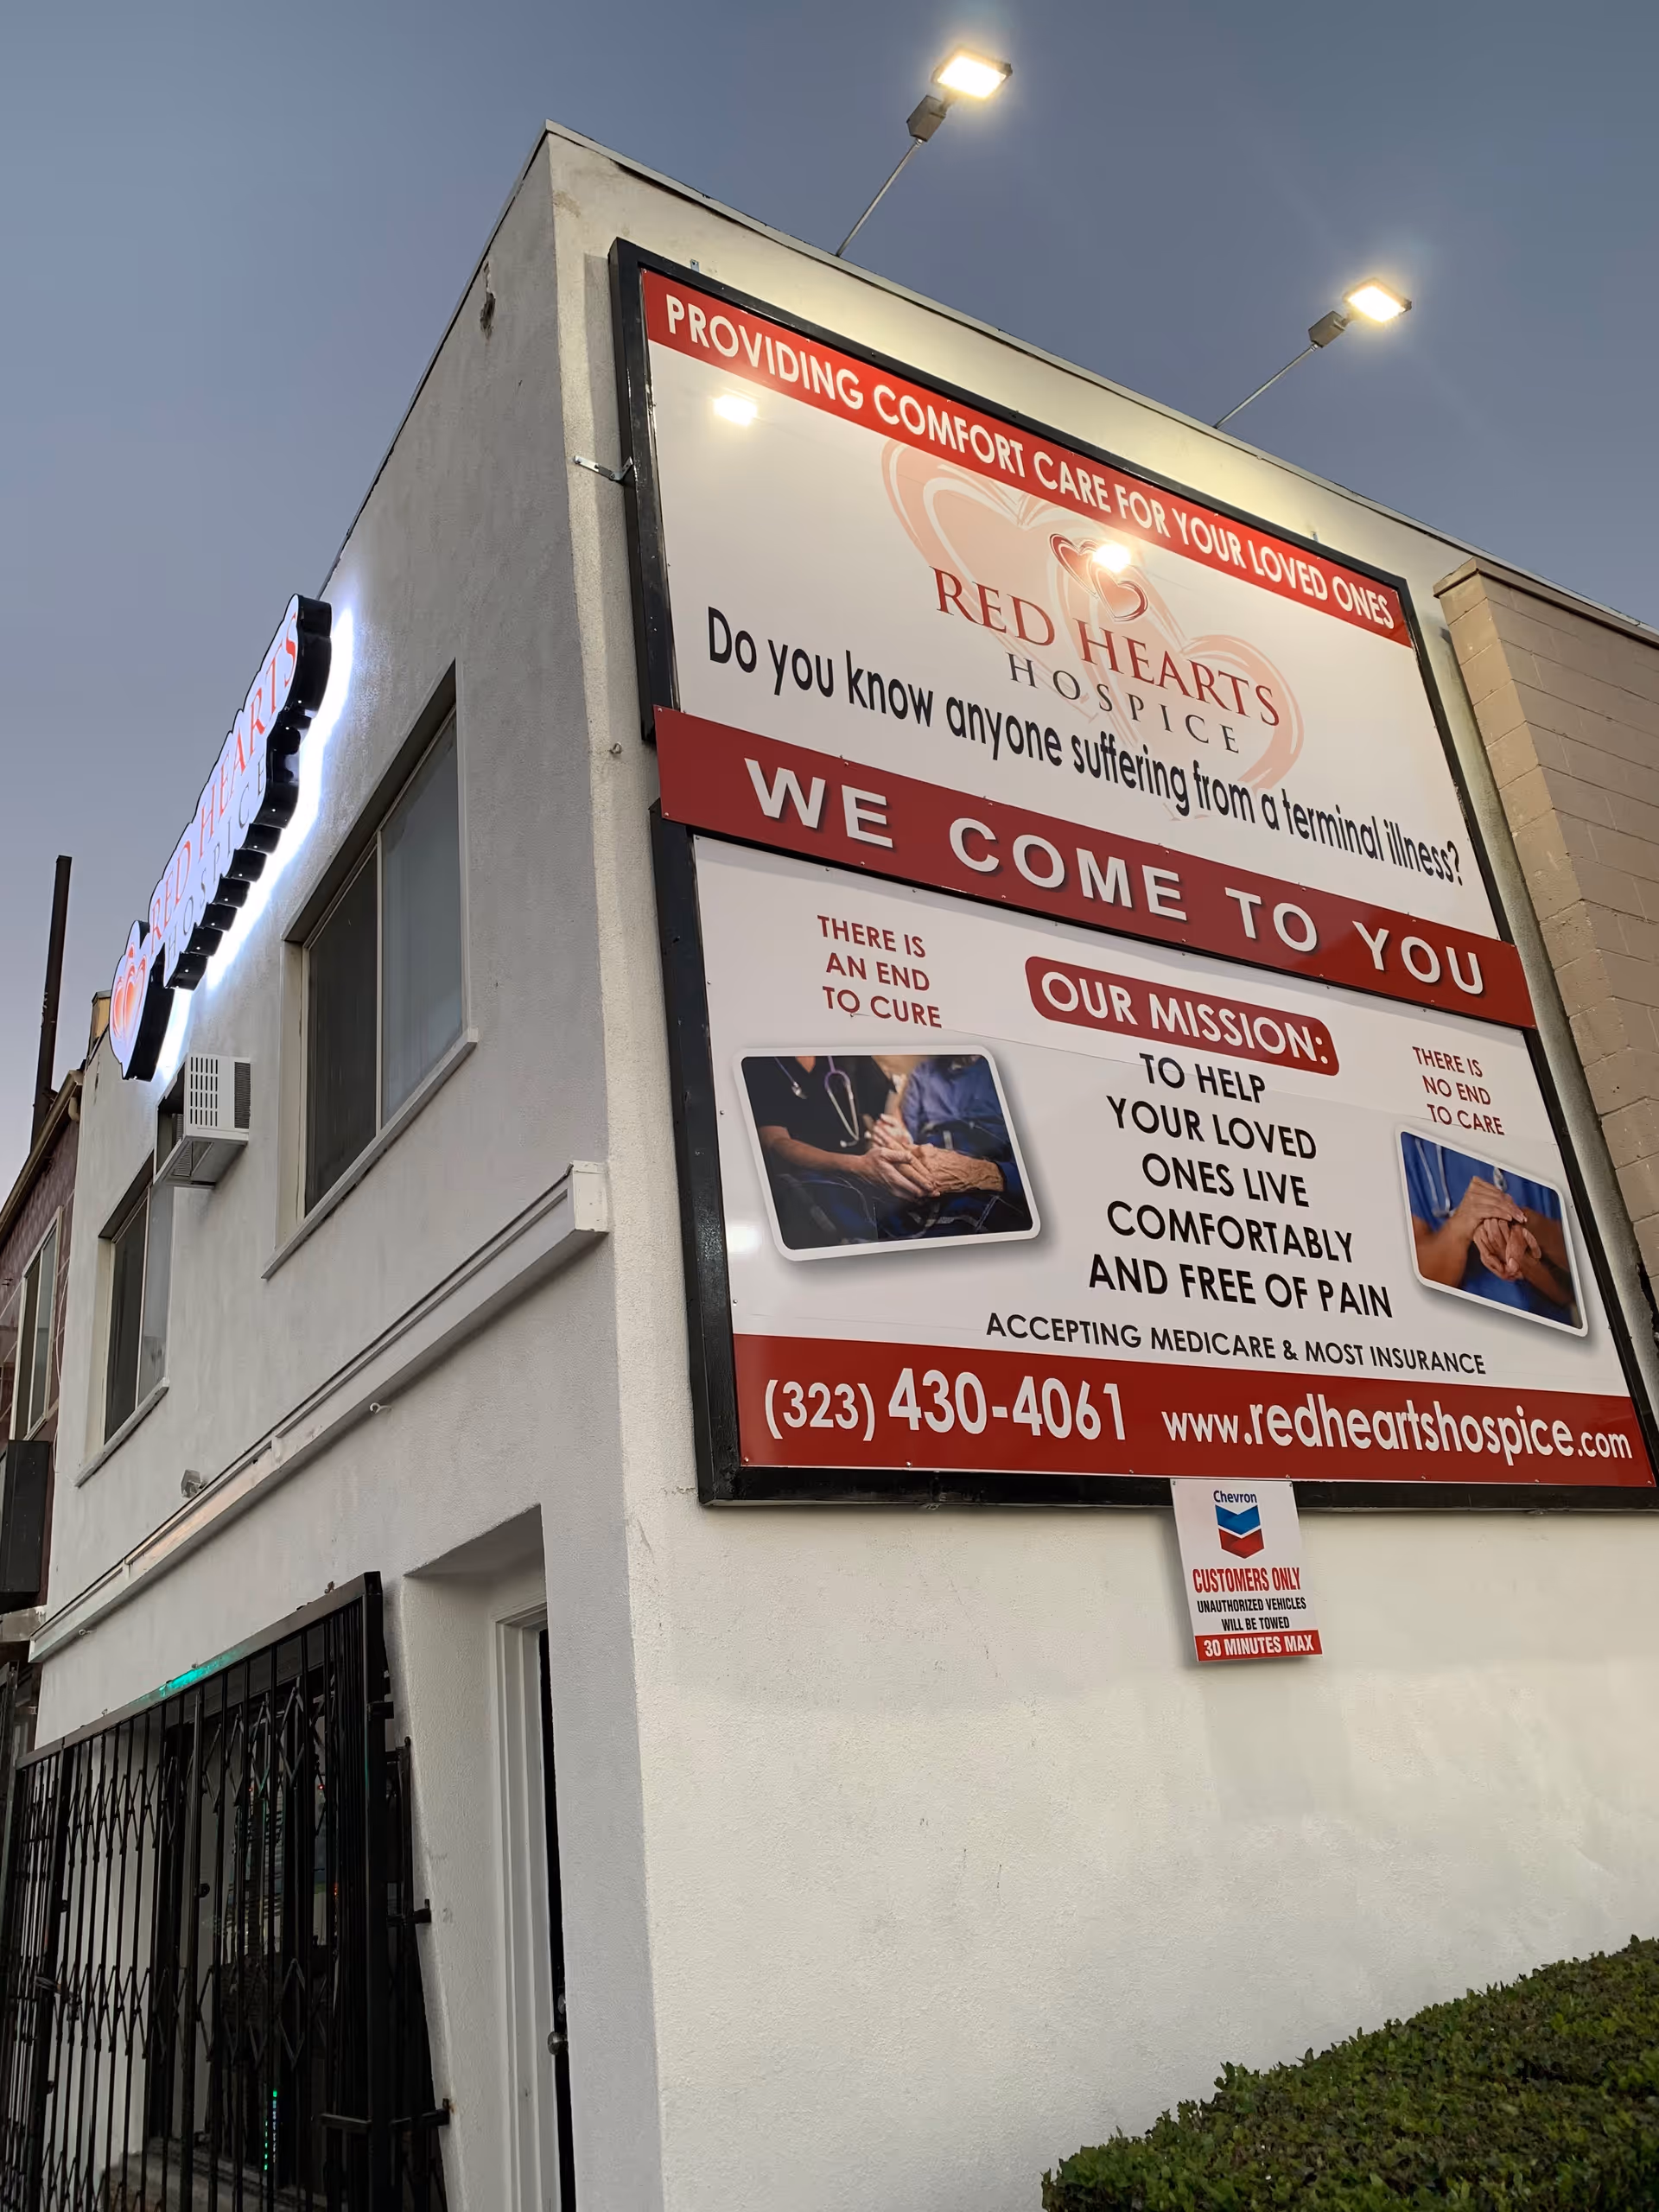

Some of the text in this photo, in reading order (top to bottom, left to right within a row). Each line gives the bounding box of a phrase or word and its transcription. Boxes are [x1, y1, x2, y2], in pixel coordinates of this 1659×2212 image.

[666, 294, 1394, 629] PROVIDING COMFORT CARE FOR YOUR LOVED ONES
[930, 566, 1279, 726] RED HEARTS
[1005, 652, 1239, 753] HOSPICE
[708, 606, 1463, 886] Do you know anyone suffering from a terminal illness?
[150, 611, 296, 957] RED HEARTS
[167, 753, 264, 970] HOSPICE
[744, 758, 1484, 995] WE COME TO YOU
[817, 915, 925, 957] THERE IS
[826, 952, 930, 991] AN END
[823, 986, 942, 1028] TO CURE
[1041, 971, 1329, 1065] OUR MISSION:
[1139, 1052, 1266, 1103] TO HELP
[1412, 1046, 1483, 1077] THERE IS
[1422, 1075, 1491, 1105] NO END
[1106, 1096, 1317, 1160] YOUR LOVED
[1427, 1103, 1504, 1135] TO CARE
[1142, 1153, 1310, 1207] ONES LIVE
[1108, 1200, 1353, 1262] COMFORTABLY
[1089, 1254, 1393, 1319] AND FREE OF PAIN
[987, 1313, 1486, 1375] ACCEPTING MEDICARE & MOST INSURANCE
[765, 1367, 1126, 1441] (323) 430-4061
[1160, 1393, 1633, 1466] www.redheartshospice.com
[1213, 1490, 1257, 1503] Chevron
[1192, 1567, 1301, 1593] CUSTOMERS ONLY
[1197, 1597, 1306, 1613] UNAUTHORIZED VEHICLES
[1204, 1634, 1314, 1656] 30 MINUTES MAX
[1222, 1617, 1290, 1631] WILL BE TOWED
